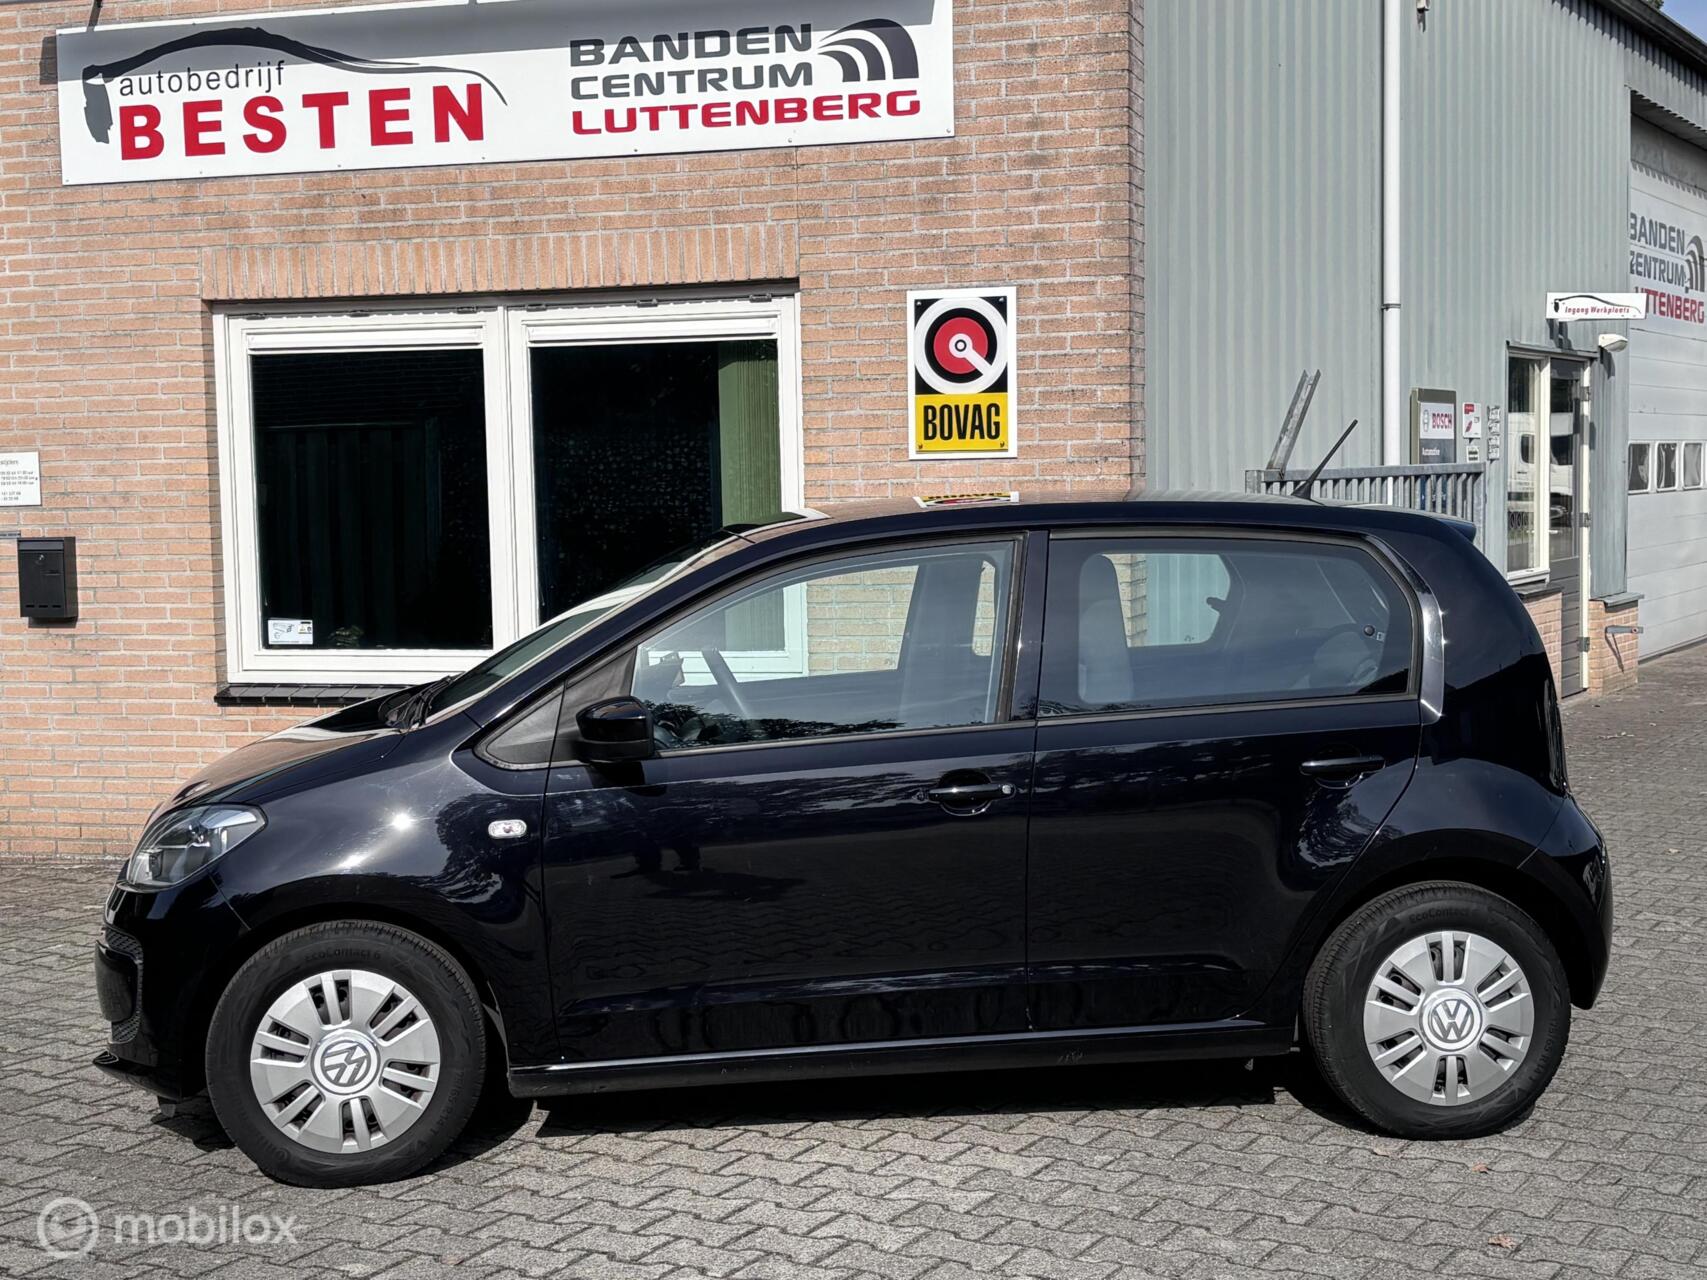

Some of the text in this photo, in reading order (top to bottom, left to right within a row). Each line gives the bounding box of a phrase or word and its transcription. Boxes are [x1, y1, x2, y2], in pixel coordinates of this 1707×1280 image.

[570, 23, 812, 67] BANDEN
[120, 61, 284, 96] autobedrijf
[571, 62, 813, 99] CENTRUM
[119, 83, 484, 160] BESTEN
[572, 90, 920, 135] LUTTENBERG
[1630, 212, 1685, 256] BANDEN
[1635, 282, 1705, 324] TTENBERG
[923, 403, 1000, 441] BOVAG
[1432, 412, 1452, 430] BOSCH
